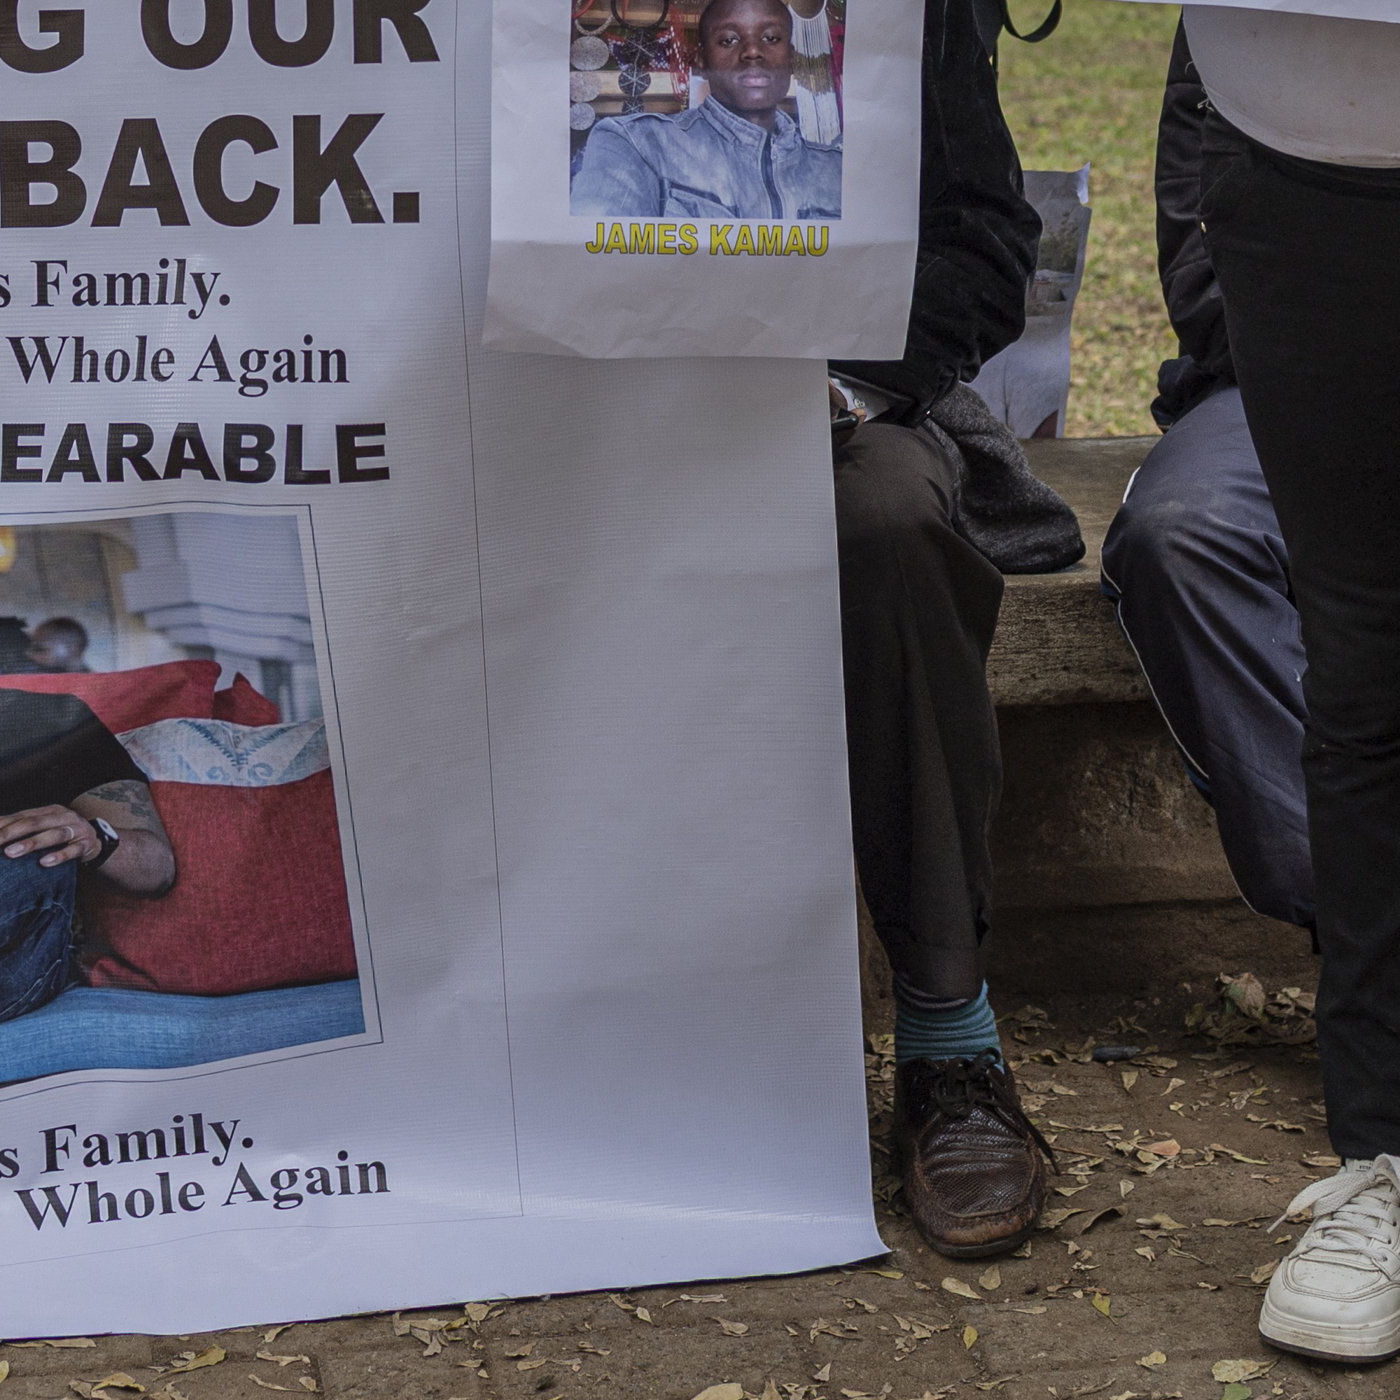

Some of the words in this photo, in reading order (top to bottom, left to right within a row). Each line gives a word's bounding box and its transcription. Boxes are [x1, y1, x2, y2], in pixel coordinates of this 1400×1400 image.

[586, 223, 698, 255] JAMES
[710, 225, 829, 257] KAMAU
[30, 258, 230, 319] Family.
[6, 335, 174, 384] Whole
[190, 335, 349, 397] Again
[39, 1113, 253, 1174] Family.
[14, 1172, 205, 1230] Whole
[222, 1150, 390, 1210] Again
